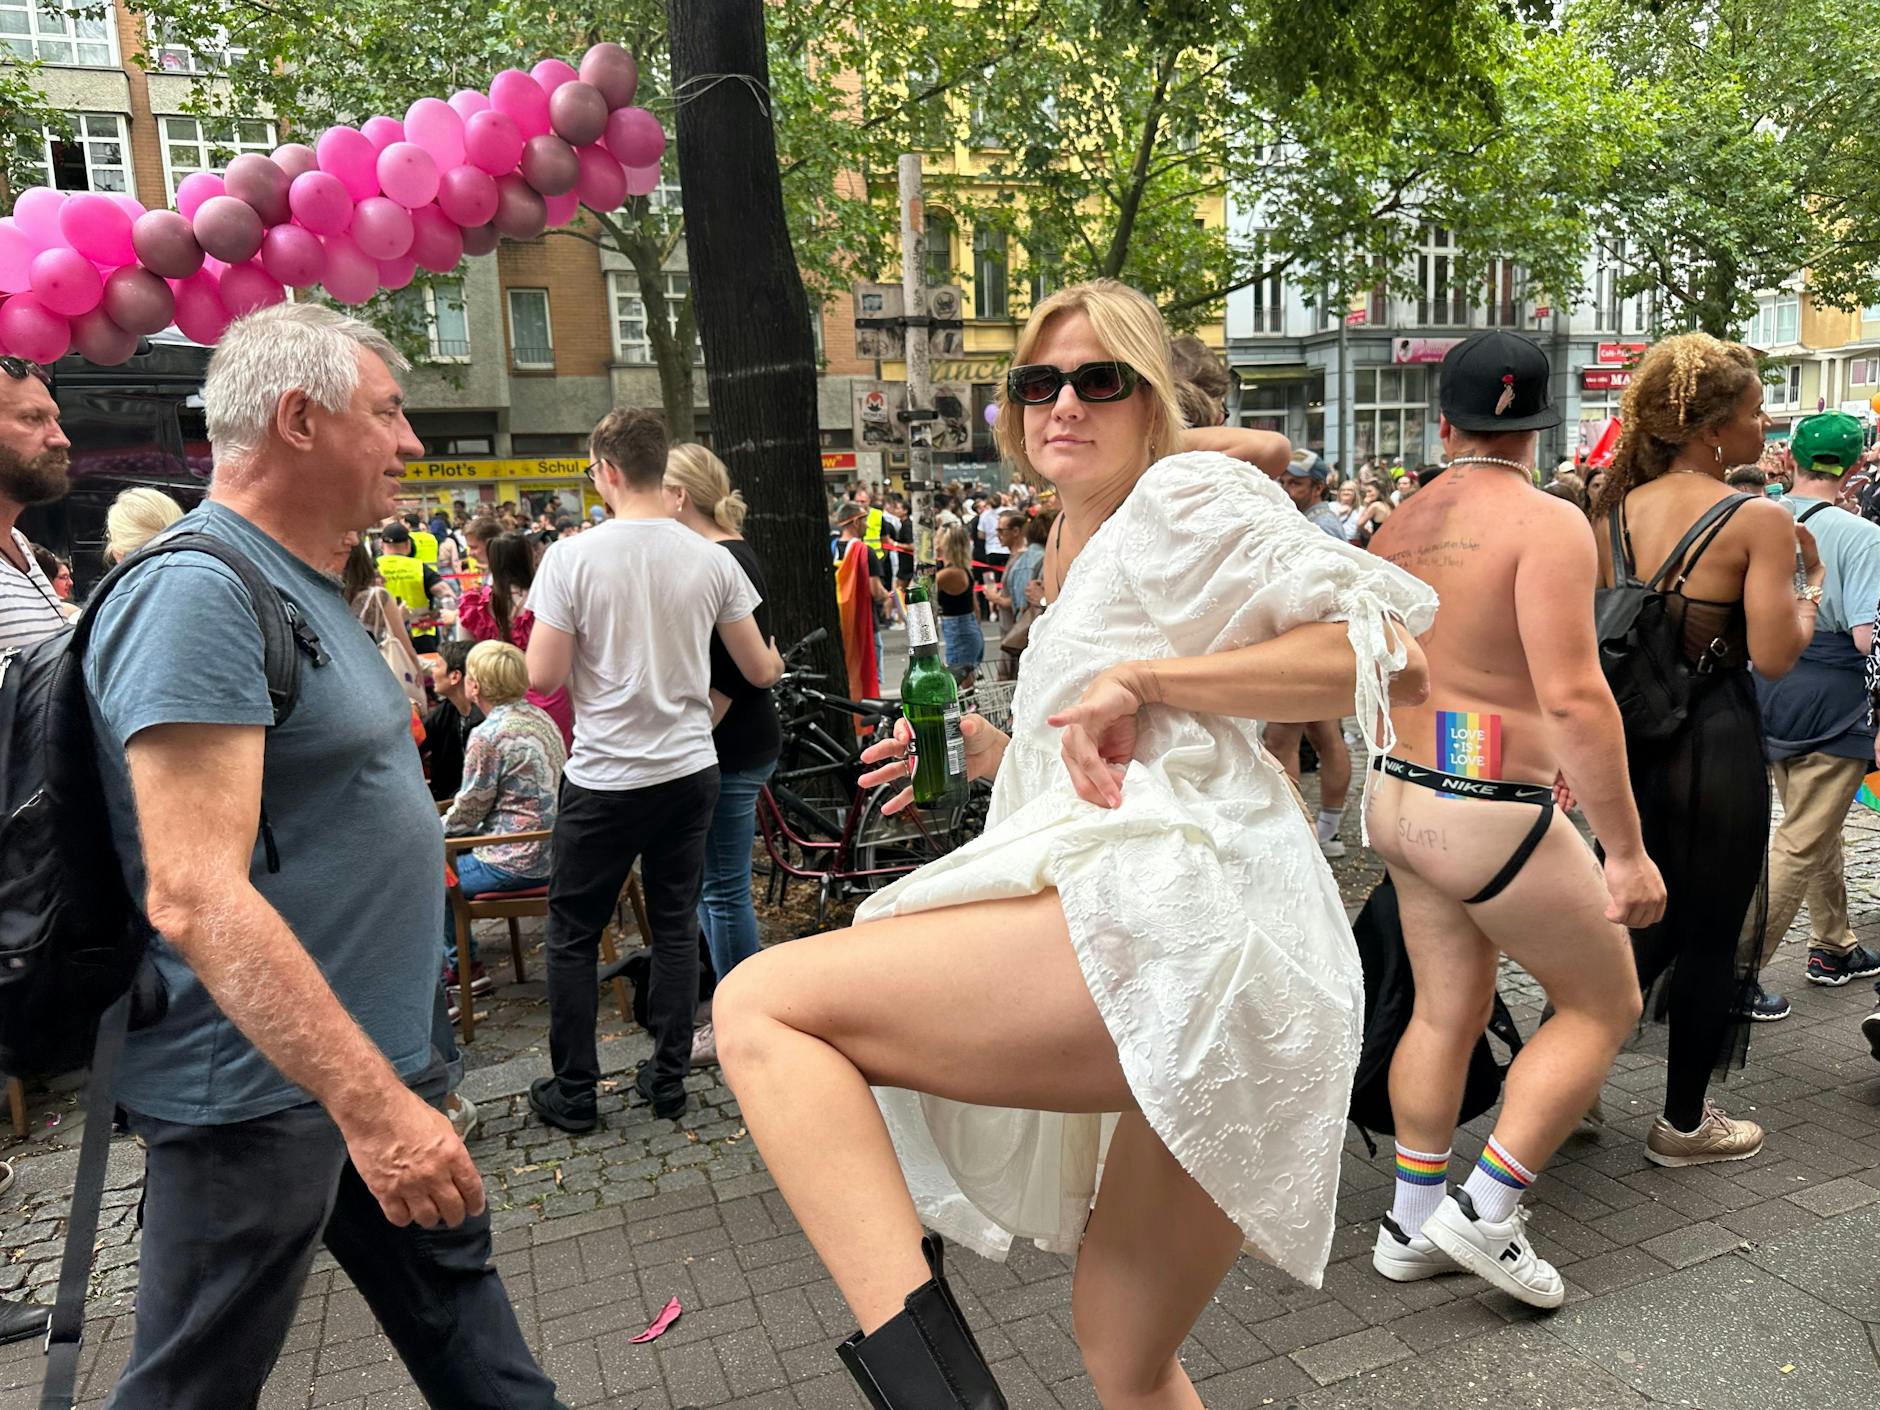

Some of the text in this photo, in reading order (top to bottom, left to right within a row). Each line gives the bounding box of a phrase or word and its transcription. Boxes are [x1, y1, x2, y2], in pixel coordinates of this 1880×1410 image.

[429, 463, 477, 477] Plot's
[538, 460, 579, 474] Schul
[1450, 727, 1486, 741] LOVE
[1461, 741, 1474, 752] IS
[1450, 753, 1486, 767] LOVE
[1384, 759, 1499, 796] NIK NIKE
[1398, 816, 1448, 851] SLAP!
